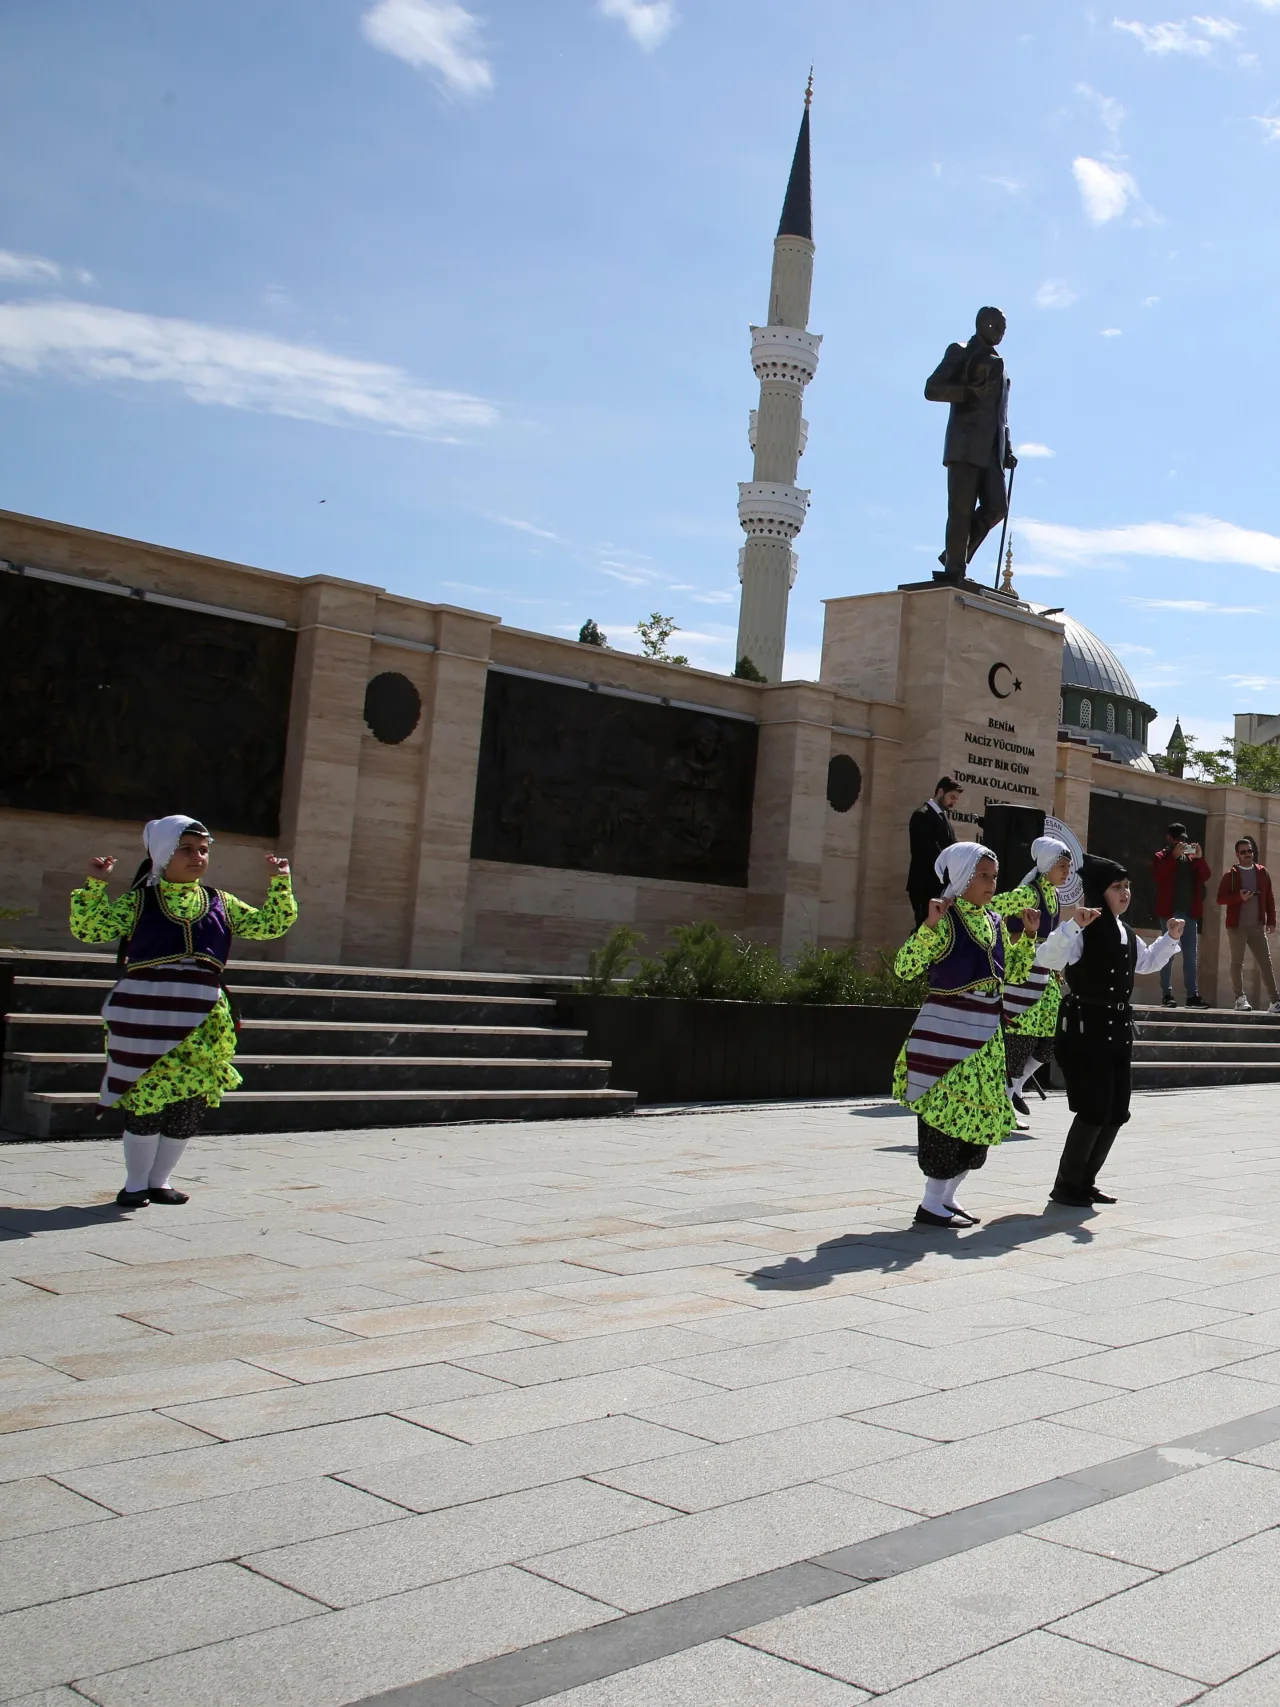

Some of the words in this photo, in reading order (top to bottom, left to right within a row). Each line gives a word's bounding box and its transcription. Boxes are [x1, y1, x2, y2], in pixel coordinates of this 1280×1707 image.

[988, 717, 1015, 733] BENİM
[964, 732, 992, 748] NACİZ
[993, 738, 1035, 757] VÜCUDUM
[968, 753, 993, 768] ELBET
[994, 758, 1009, 771] BİR
[1010, 761, 1030, 775] GÜN
[953, 770, 989, 787] TOPRAK
[989, 777, 1040, 797] OLACAKTIR.
[1044, 819, 1063, 832] EŞAN
